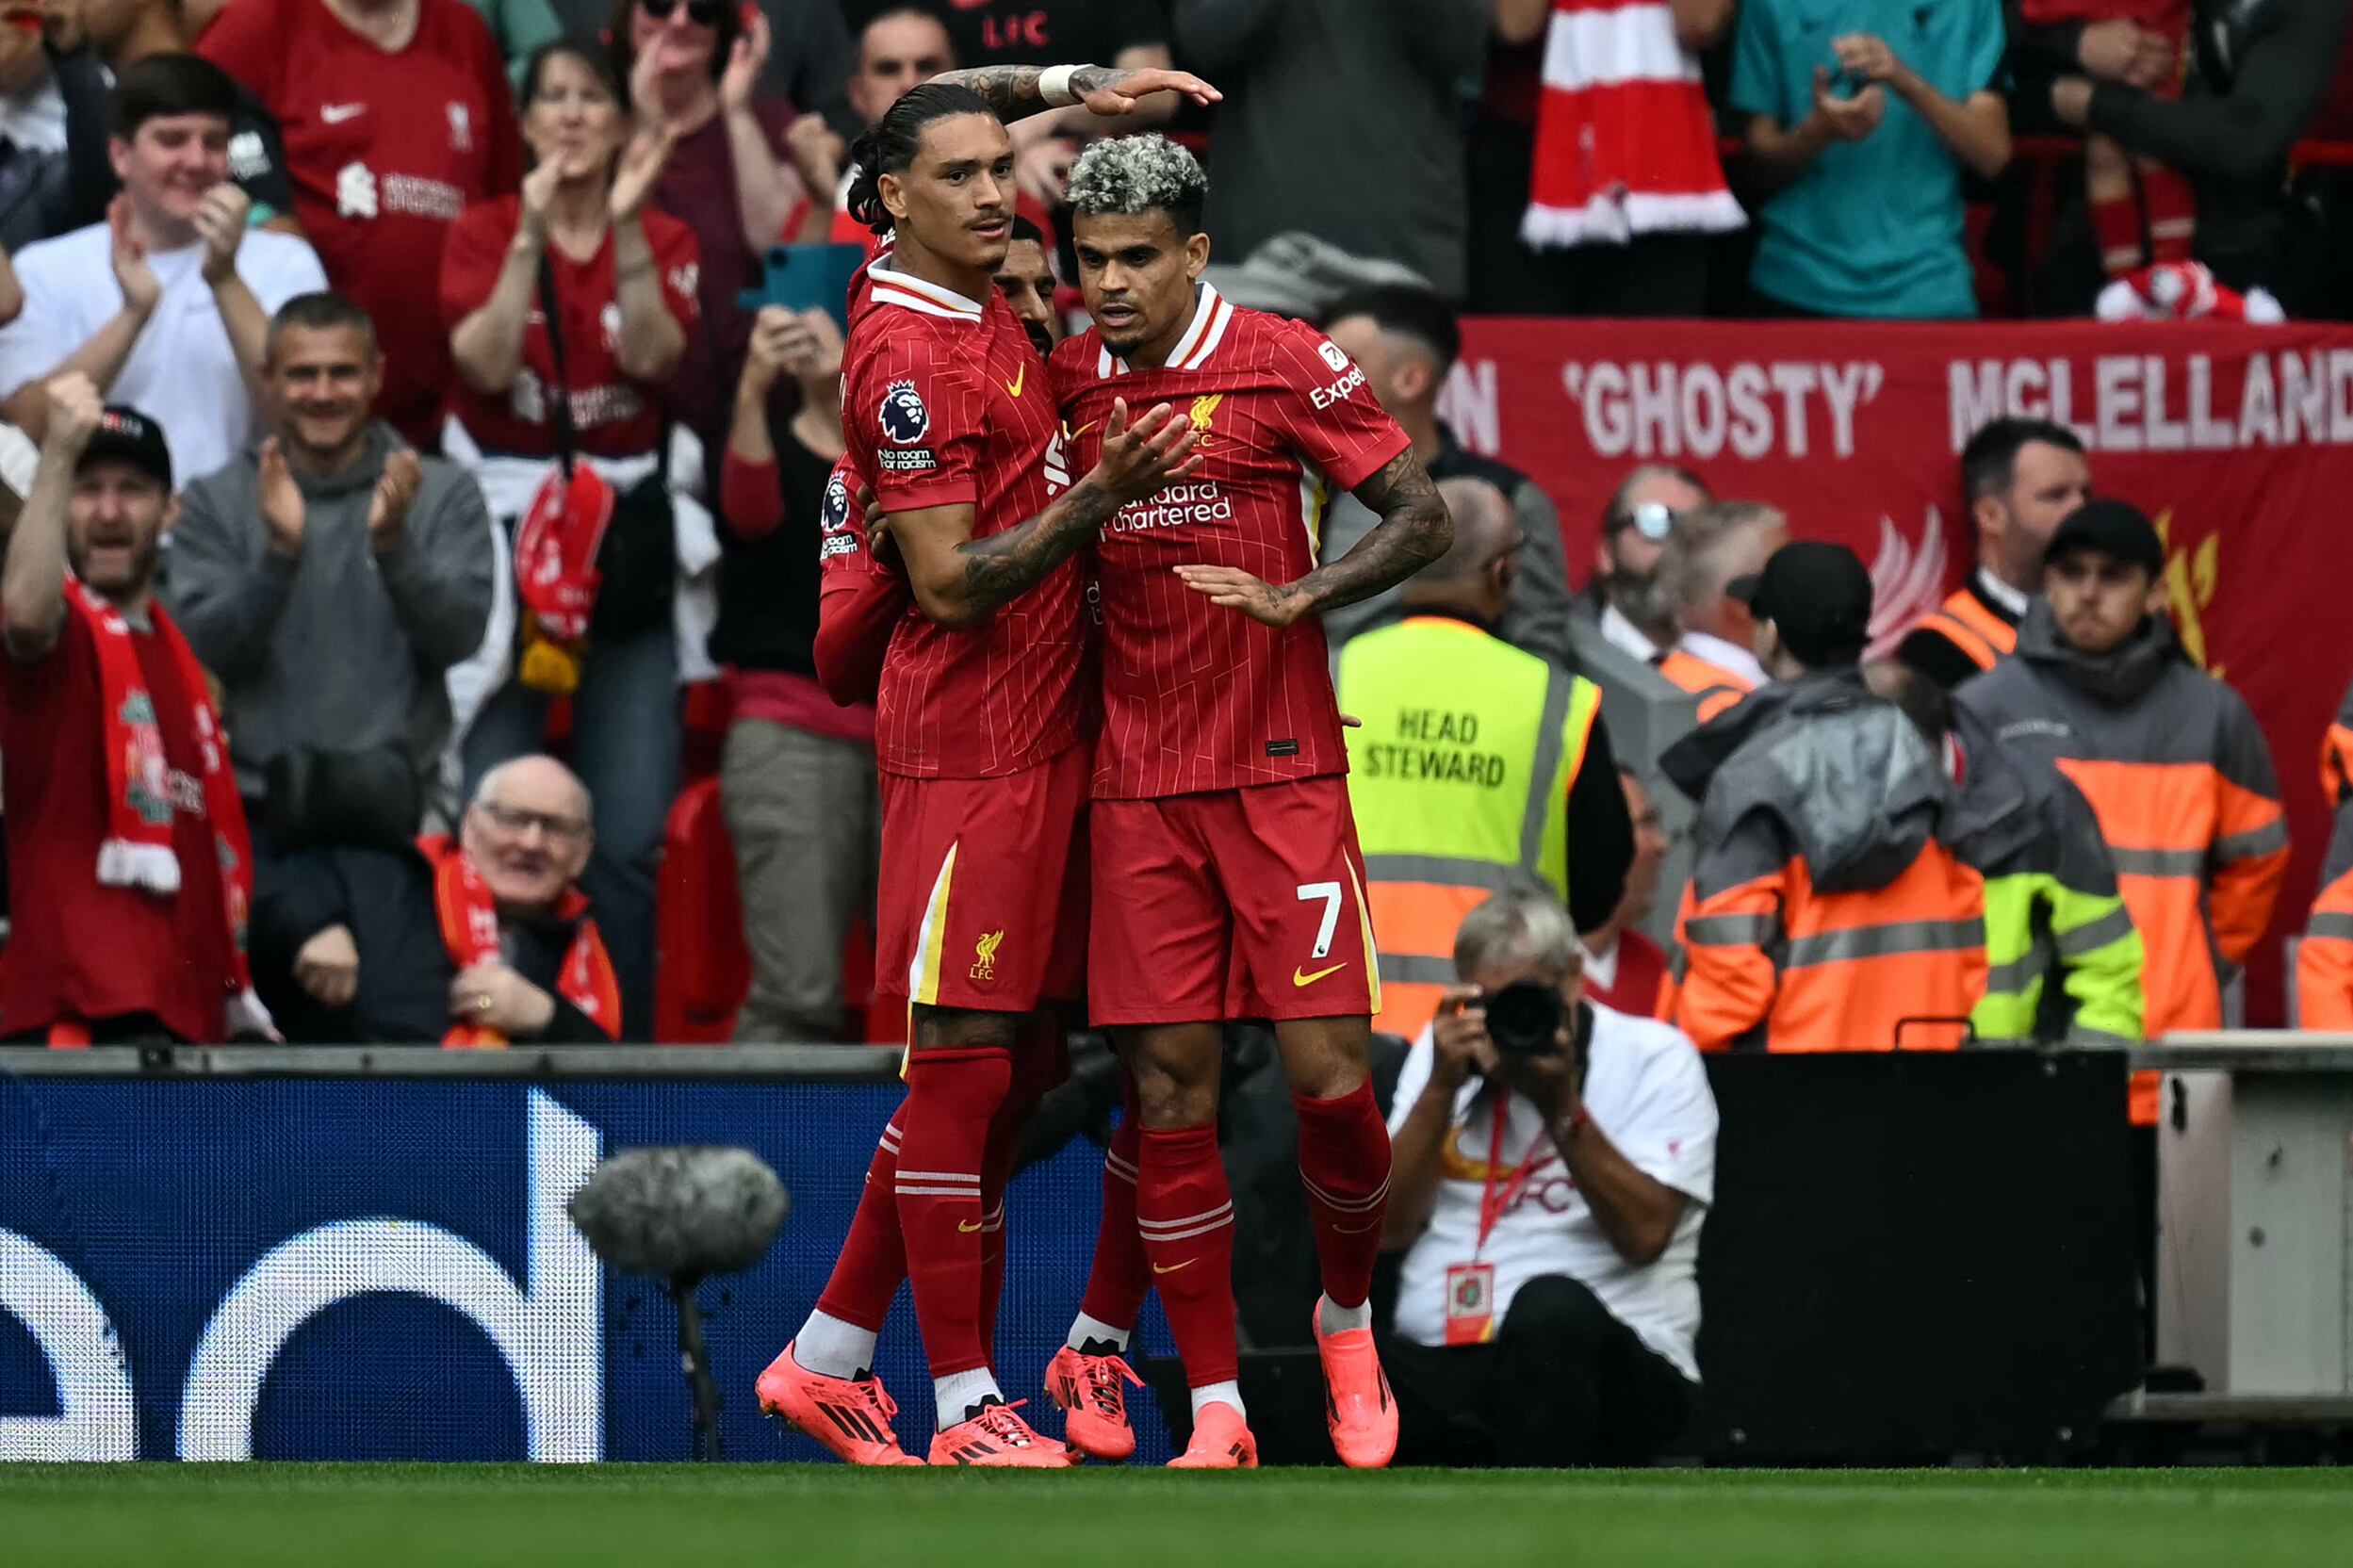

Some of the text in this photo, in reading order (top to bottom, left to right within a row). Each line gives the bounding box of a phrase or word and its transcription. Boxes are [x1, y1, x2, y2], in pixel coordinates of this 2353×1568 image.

[1432, 359, 1500, 456] N
[877, 449, 930, 460] No room
[879, 460, 937, 469] For racism
[1112, 497, 1231, 532] chartered
[1398, 709, 1478, 744] HEAD
[1364, 743, 1506, 787] STEWARD
[1297, 881, 1342, 958] 7
